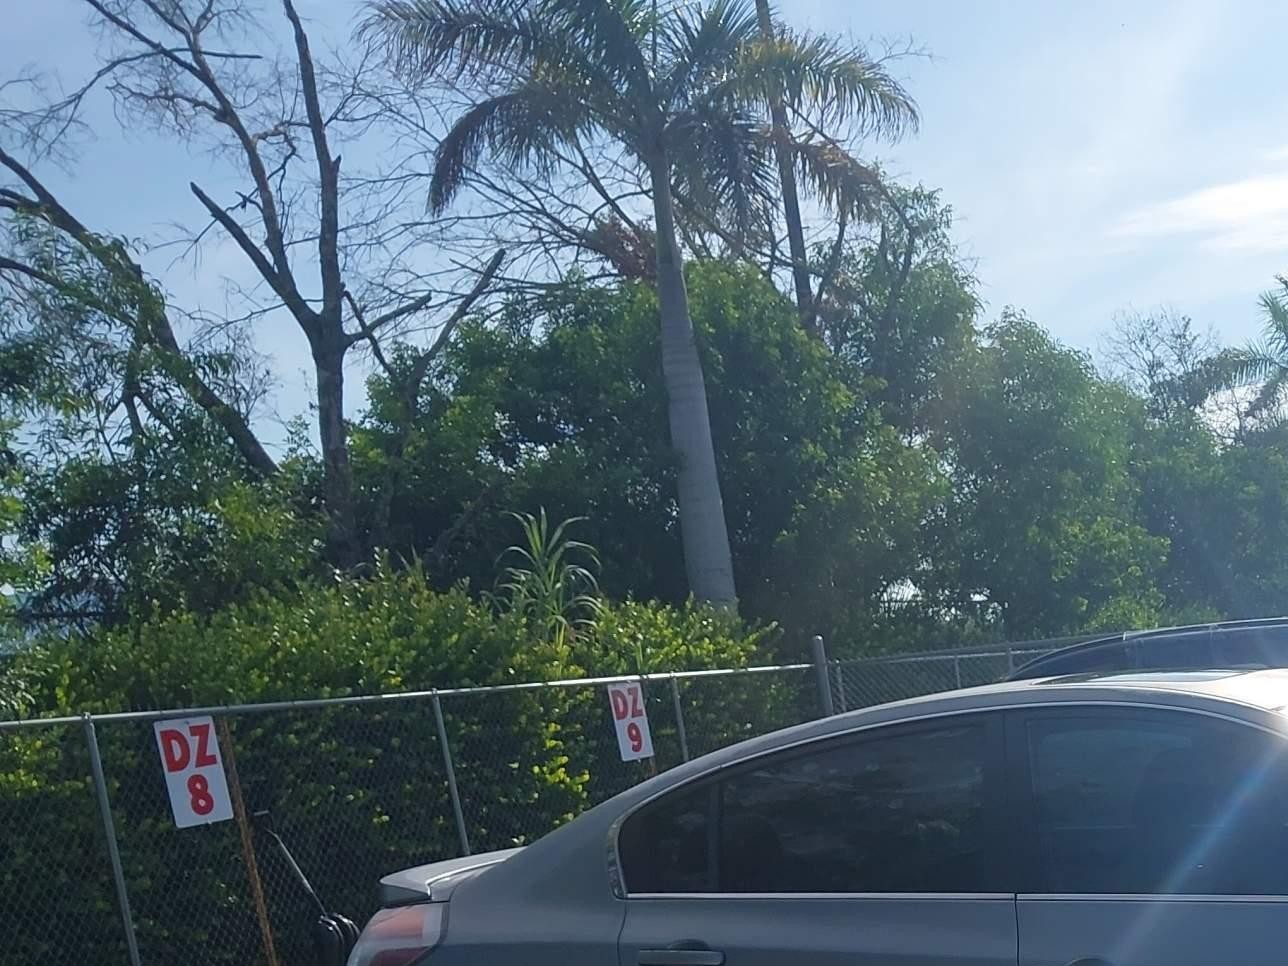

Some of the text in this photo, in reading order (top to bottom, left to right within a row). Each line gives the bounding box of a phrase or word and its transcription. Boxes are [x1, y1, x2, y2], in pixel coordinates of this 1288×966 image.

[611, 687, 644, 720] DZ
[159, 723, 218, 773] DZ
[627, 722, 643, 752] 9
[187, 774, 214, 815] 8
